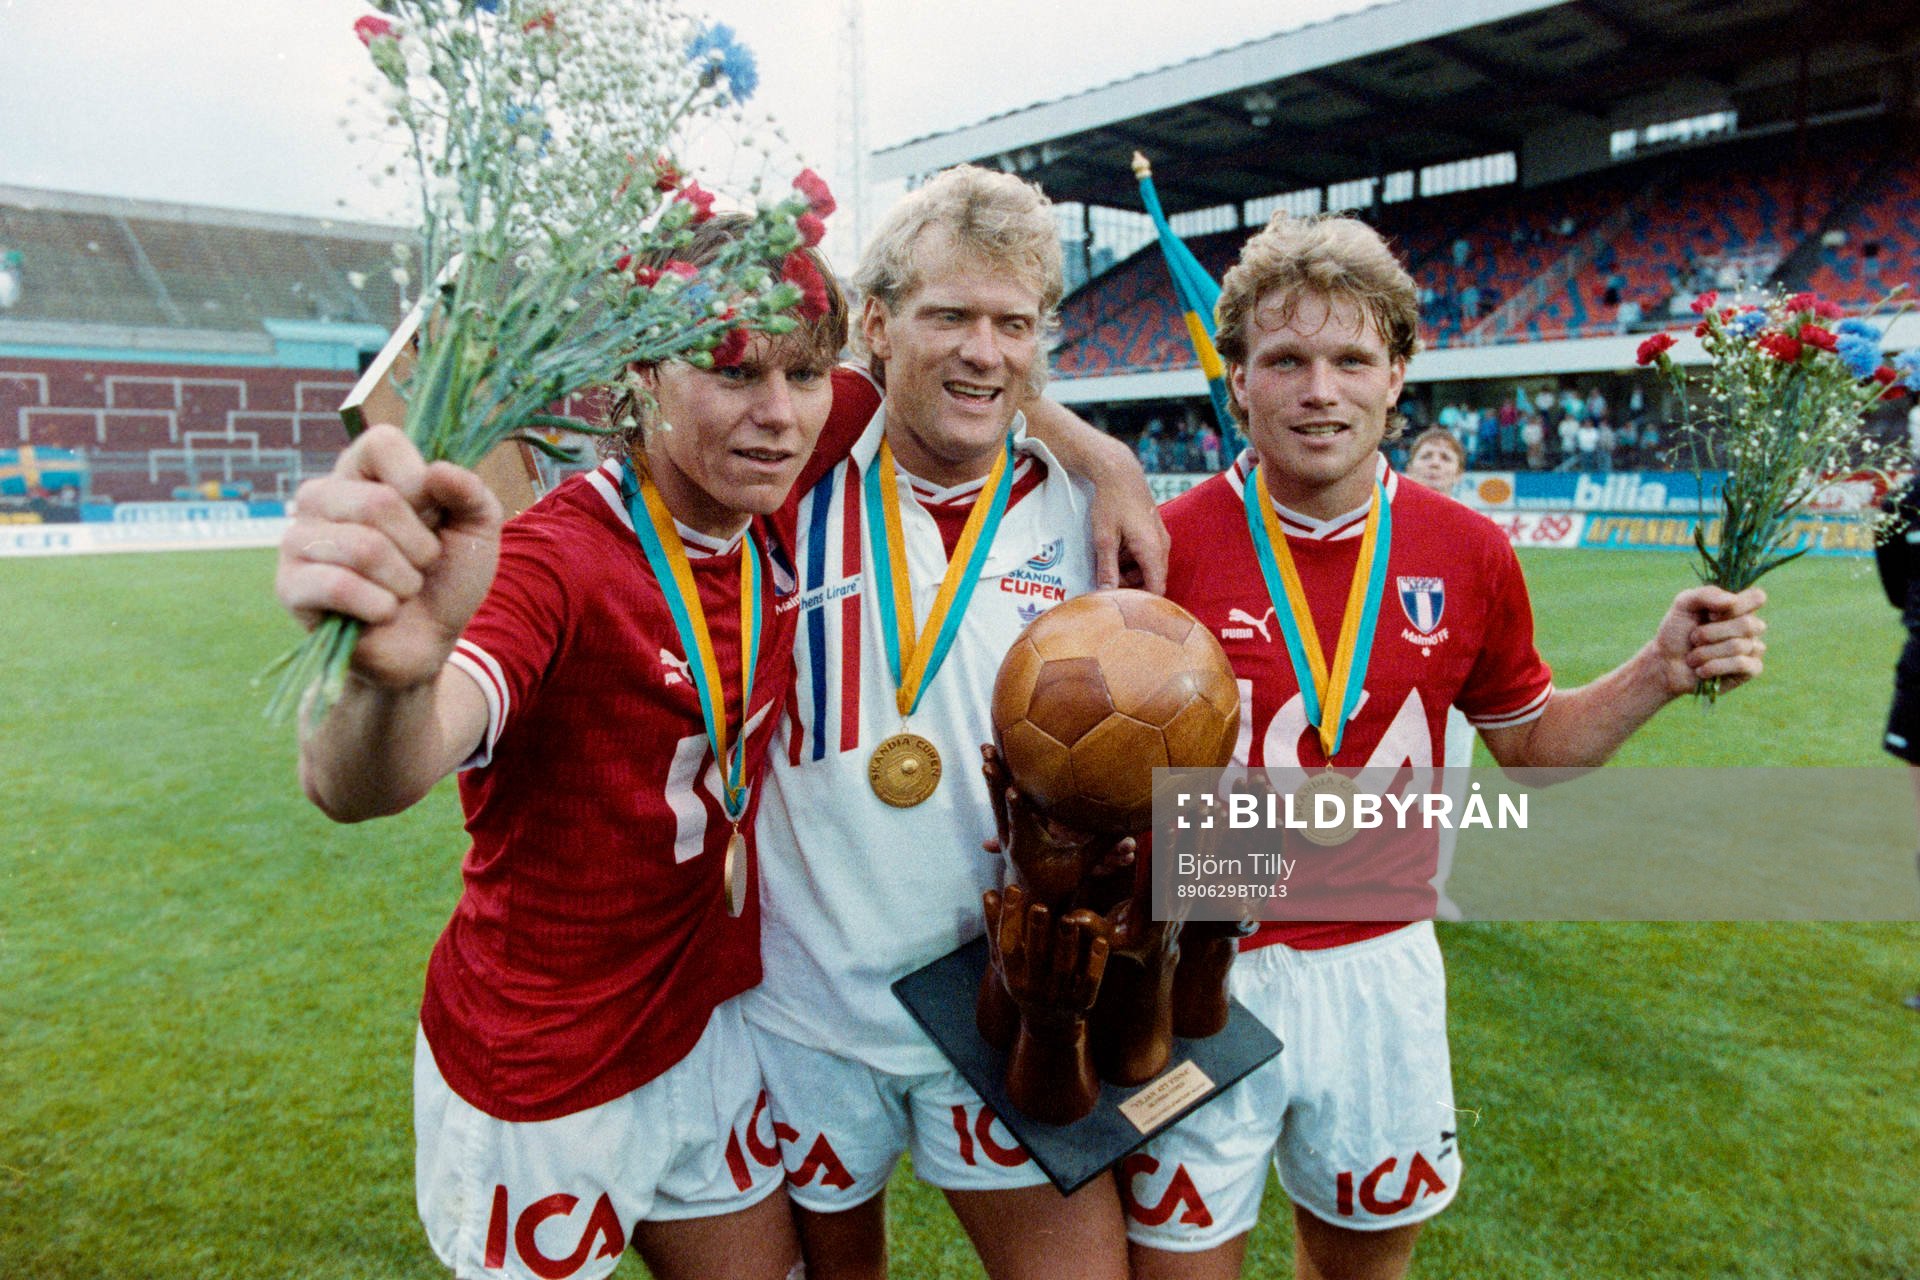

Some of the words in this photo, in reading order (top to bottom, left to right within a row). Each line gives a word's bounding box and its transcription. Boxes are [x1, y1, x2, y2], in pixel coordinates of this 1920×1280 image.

[1531, 514, 1572, 541] 89
[826, 581, 857, 600] Lirare
[1000, 577, 1066, 602] CUPEN
[1008, 568, 1063, 586] SKANDIA
[872, 737, 911, 781] SKANDIA
[916, 740, 940, 778] CUPEN
[1336, 1151, 1447, 1217] ICA
[484, 1184, 626, 1280] ICA
